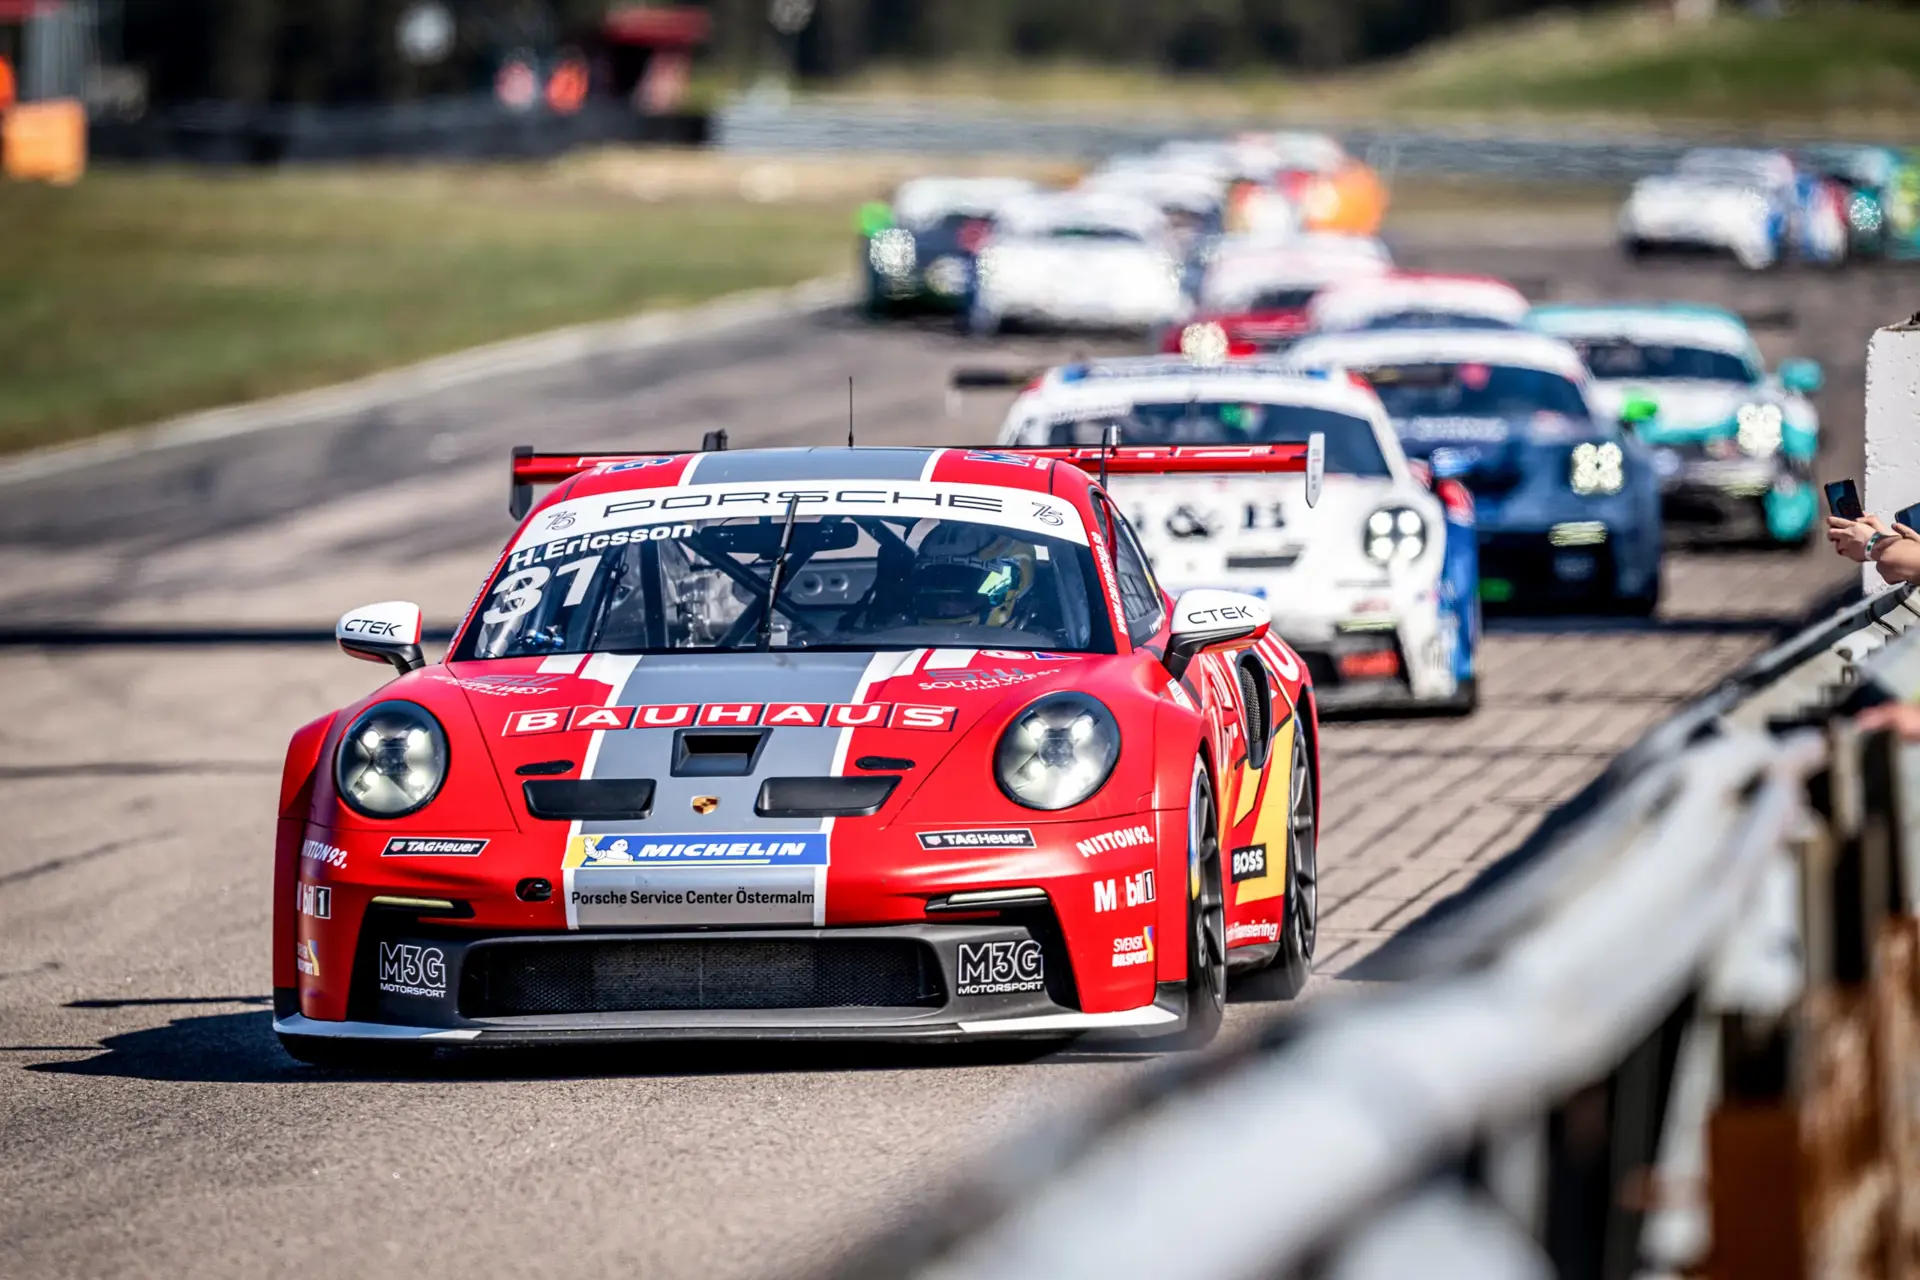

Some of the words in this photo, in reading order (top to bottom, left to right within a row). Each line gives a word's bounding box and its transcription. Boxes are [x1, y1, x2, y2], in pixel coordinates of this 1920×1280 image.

[603, 490, 1002, 518] PORSCHE
[508, 524, 693, 572] H.Ericsson
[483, 555, 602, 625] 31
[1187, 604, 1253, 625] CTEK
[344, 619, 402, 637] CTEK
[514, 704, 946, 734] BAUHAUS
[638, 842, 806, 858] MICHELIN
[1233, 850, 1264, 875] BOSS
[571, 890, 627, 905] Porsche
[630, 890, 683, 904] Service
[686, 890, 733, 904] Center
[736, 887, 815, 904] Östermalm
[380, 942, 446, 988] M3G
[958, 940, 1043, 985] M3G
[380, 982, 446, 999] MOTORSPORT
[958, 980, 1043, 995] MOTORSPORT
